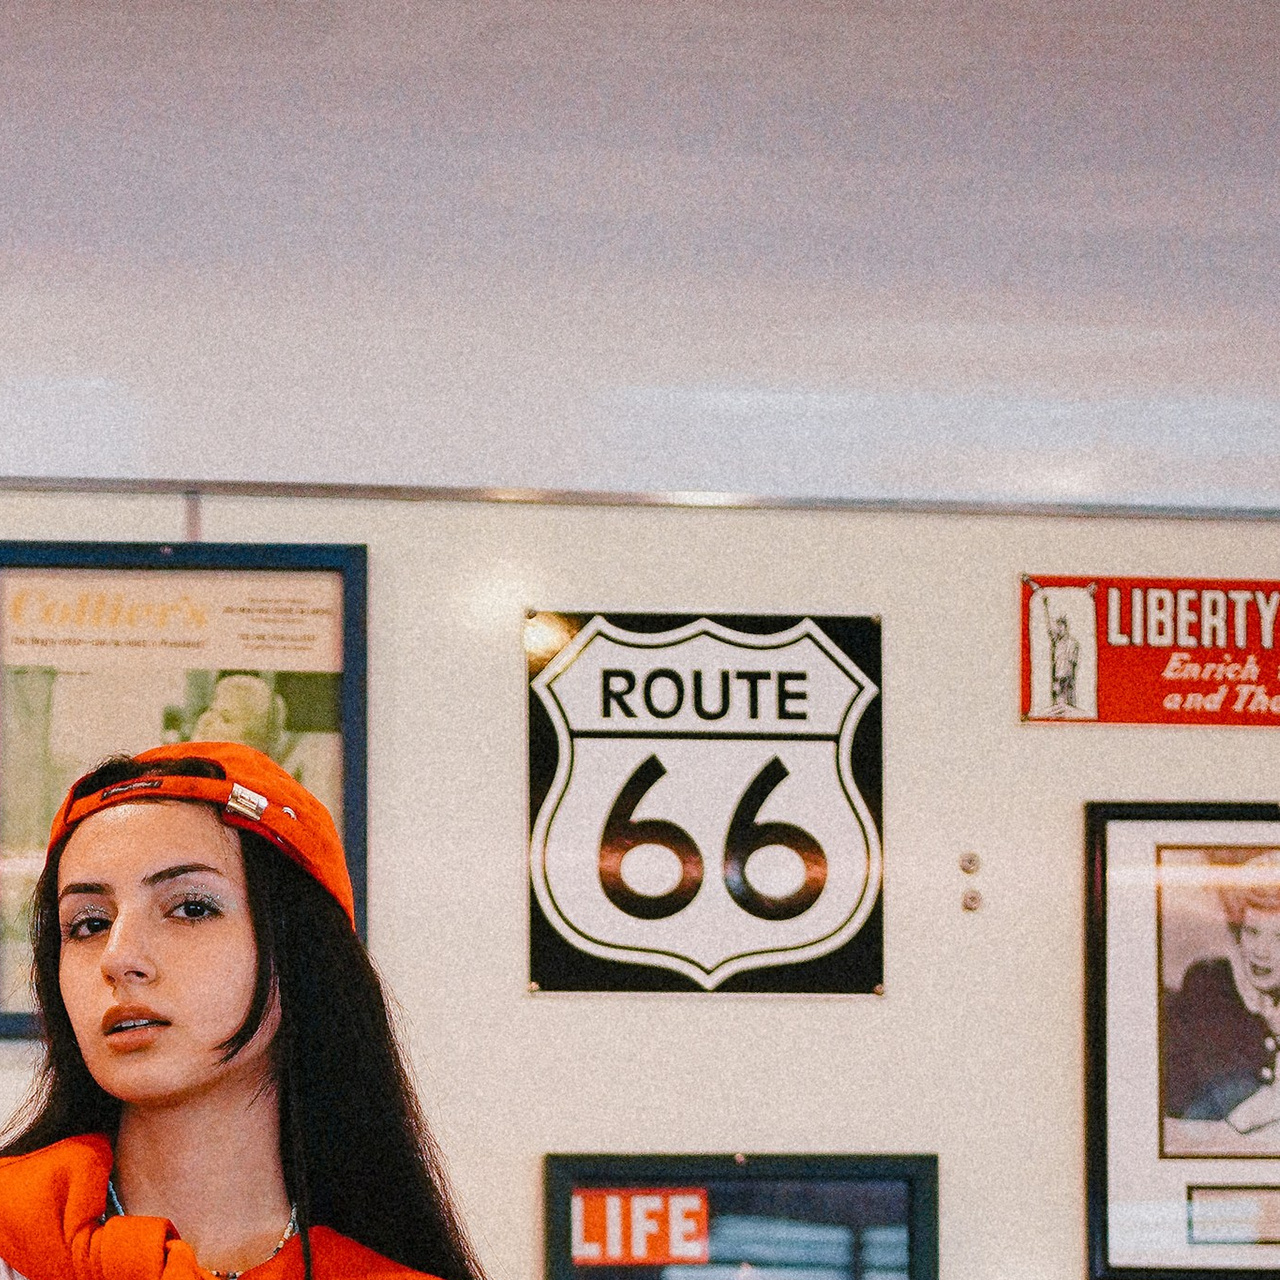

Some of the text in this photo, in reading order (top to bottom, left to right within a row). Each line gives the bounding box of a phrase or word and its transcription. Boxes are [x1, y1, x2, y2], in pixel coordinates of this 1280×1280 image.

[1107, 587, 1280, 649] LIBERTY
[600, 667, 808, 720] ROUTE
[1161, 652, 1260, 681] Enrich
[1163, 684, 1228, 711] and
[598, 752, 828, 921] 66
[572, 1194, 702, 1259] LIFE
